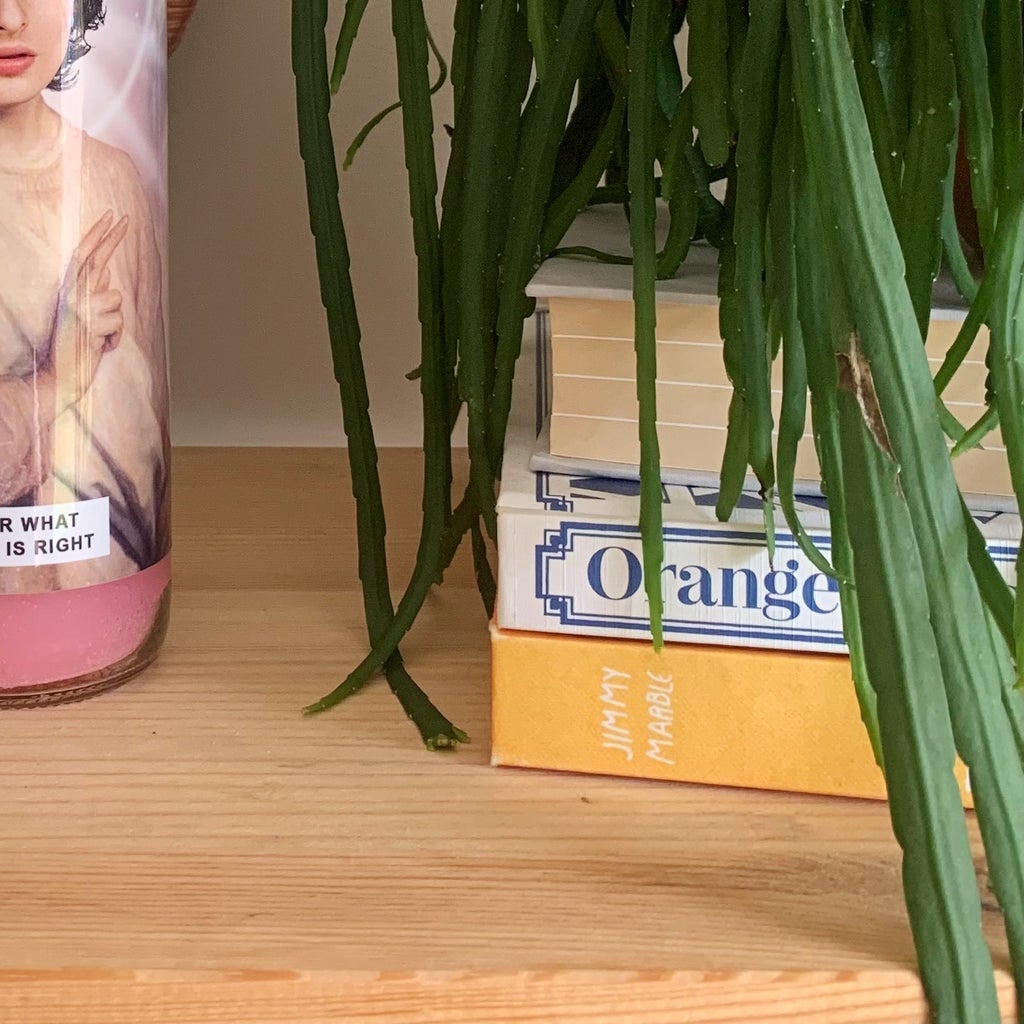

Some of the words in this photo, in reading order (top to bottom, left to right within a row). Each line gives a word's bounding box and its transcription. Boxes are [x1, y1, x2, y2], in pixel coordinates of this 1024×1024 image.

[6, 541, 25, 556] IS
[34, 533, 95, 556] RIGHT
[20, 512, 79, 532] WHAT
[599, 666, 633, 761] JIMMY
[645, 670, 675, 765] MARBLE
